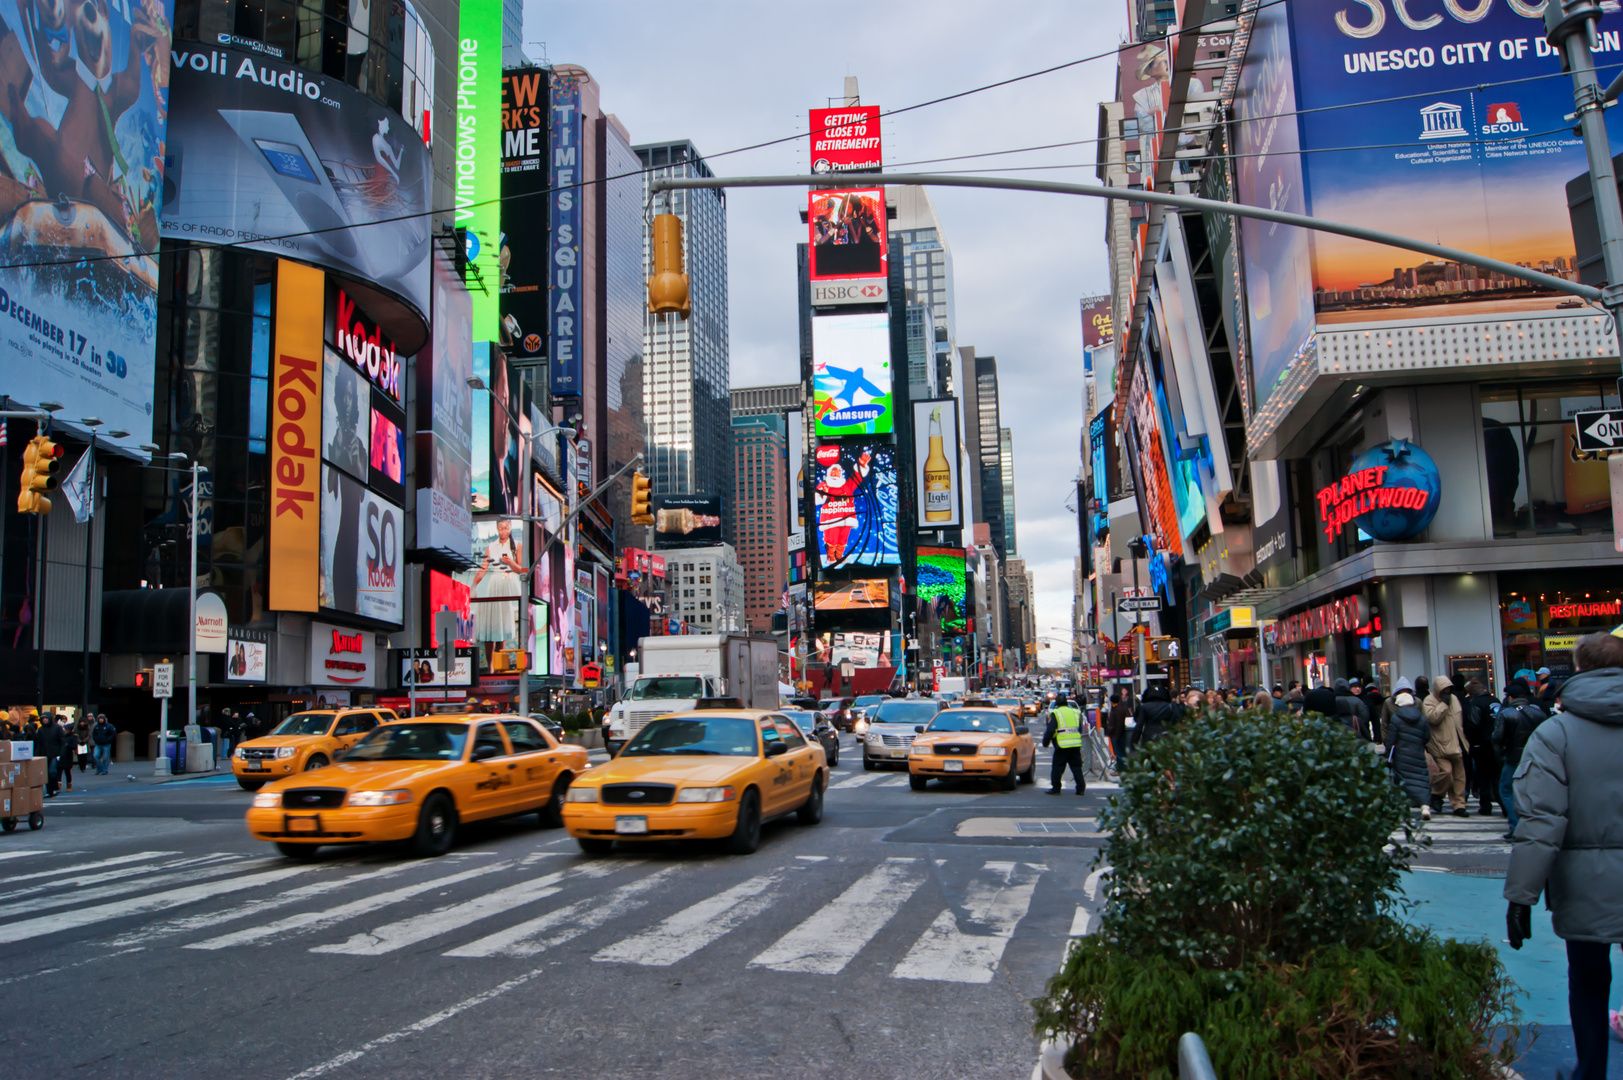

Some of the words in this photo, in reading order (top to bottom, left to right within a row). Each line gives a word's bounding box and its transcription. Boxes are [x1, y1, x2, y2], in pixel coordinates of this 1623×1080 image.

[1344, 47, 1435, 74] UNESCO
[1441, 41, 1492, 65] CITY
[1498, 38, 1529, 60] OF
[171, 51, 227, 76] voli
[235, 57, 321, 100] Audio
[457, 38, 478, 109] Phone
[501, 73, 541, 108] EW
[319, 96, 341, 110] .com
[501, 106, 541, 130] RK'S
[824, 112, 868, 127] GETTING
[1422, 110, 1462, 131] UNESCO
[825, 126, 853, 138] CLOSE
[854, 125, 867, 136] TO
[1482, 122, 1529, 134] SEOUL
[815, 137, 880, 151] RETIREMENT?
[1528, 141, 1557, 149] UNESCO
[1558, 138, 1583, 146] Creative
[555, 104, 576, 211] TIMES
[1395, 151, 1431, 160] Educational,
[1434, 154, 1472, 163] Organization
[1485, 151, 1503, 159] Cities
[1503, 149, 1528, 157] Network
[454, 112, 477, 222] Windows
[831, 159, 881, 171] Prudential
[161, 220, 179, 231] ARS
[182, 223, 198, 232] OF
[200, 225, 235, 238] RADIO
[238, 231, 300, 251] PERFECTION
[554, 224, 577, 361] SQUARE
[815, 285, 859, 300] HSBC
[0, 287, 65, 347] DECEMBER
[69, 328, 88, 356] 17
[91, 344, 102, 367] in
[106, 349, 128, 380] 3D
[334, 287, 402, 402] Kodak
[29, 333, 42, 345] also
[42, 341, 64, 360] playing
[65, 351, 71, 361] in
[72, 355, 80, 366] 2D
[80, 360, 103, 378] theaters
[829, 410, 879, 421] SAMSUNG
[275, 353, 318, 521] Kodak
[816, 448, 839, 459] Coca-Cola
[927, 492, 949, 503] Light
[1316, 466, 1388, 522] PLANET
[820, 506, 856, 514] happiness
[828, 500, 847, 508] open
[1324, 487, 1429, 544] HOLLYWOOD
[367, 559, 396, 588] Kodak
[1299, 594, 1360, 640] HOLLYWOOD
[1549, 603, 1621, 618] RESTAURANT
[196, 616, 224, 626] Marriott
[228, 628, 267, 640] MARQUIS
